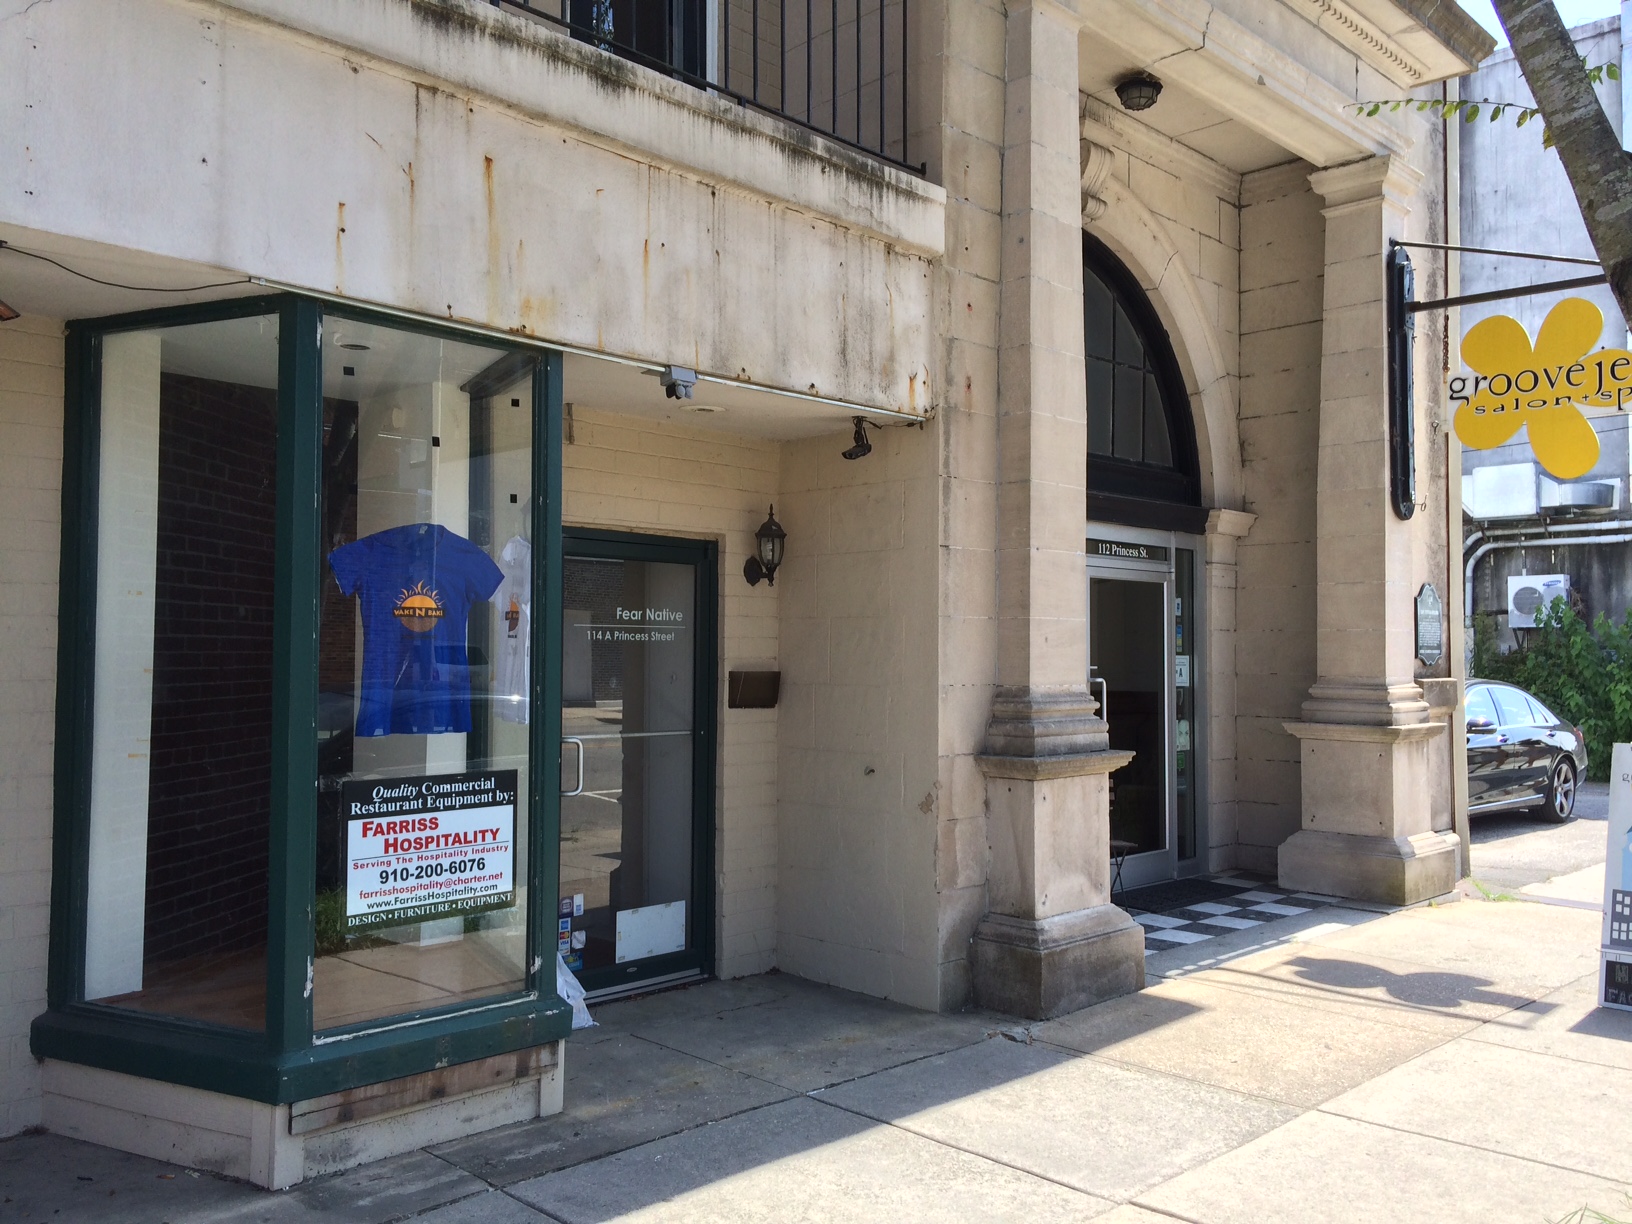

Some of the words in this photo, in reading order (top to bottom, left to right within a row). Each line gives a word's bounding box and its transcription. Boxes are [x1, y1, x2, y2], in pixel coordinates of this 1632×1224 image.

[1475, 395, 1572, 415] salon
[1098, 543, 1111, 554] 112
[1111, 544, 1139, 557] Princess
[1139, 546, 1149, 558] St.
[415, 607, 426, 617] N
[616, 606, 643, 620] Fear
[646, 607, 683, 621] Native
[586, 630, 602, 640] 114
[604, 630, 612, 640] A
[614, 630, 649, 641] Princess
[650, 631, 675, 641] Street
[372, 784, 418, 801] Quality
[421, 777, 495, 795] Commercial
[350, 798, 423, 815] Restaurant
[426, 791, 493, 810] Equipment
[496, 790, 514, 804] by:
[362, 817, 439, 838] FARRISS
[383, 828, 501, 854] HOSPITALITY
[353, 859, 392, 870] Serving
[395, 856, 413, 865] The
[417, 849, 468, 862] Hospitality
[471, 844, 509, 855] Industry
[379, 857, 485, 884] 910-200-6076
[359, 872, 503, 900] farrisshospitality@charter.net
[366, 883, 498, 910] www.FarrissHospitality.com
[348, 911, 387, 927] DESIGN
[394, 902, 451, 919] FURNITURE
[457, 892, 513, 909] EQUIPMENT
